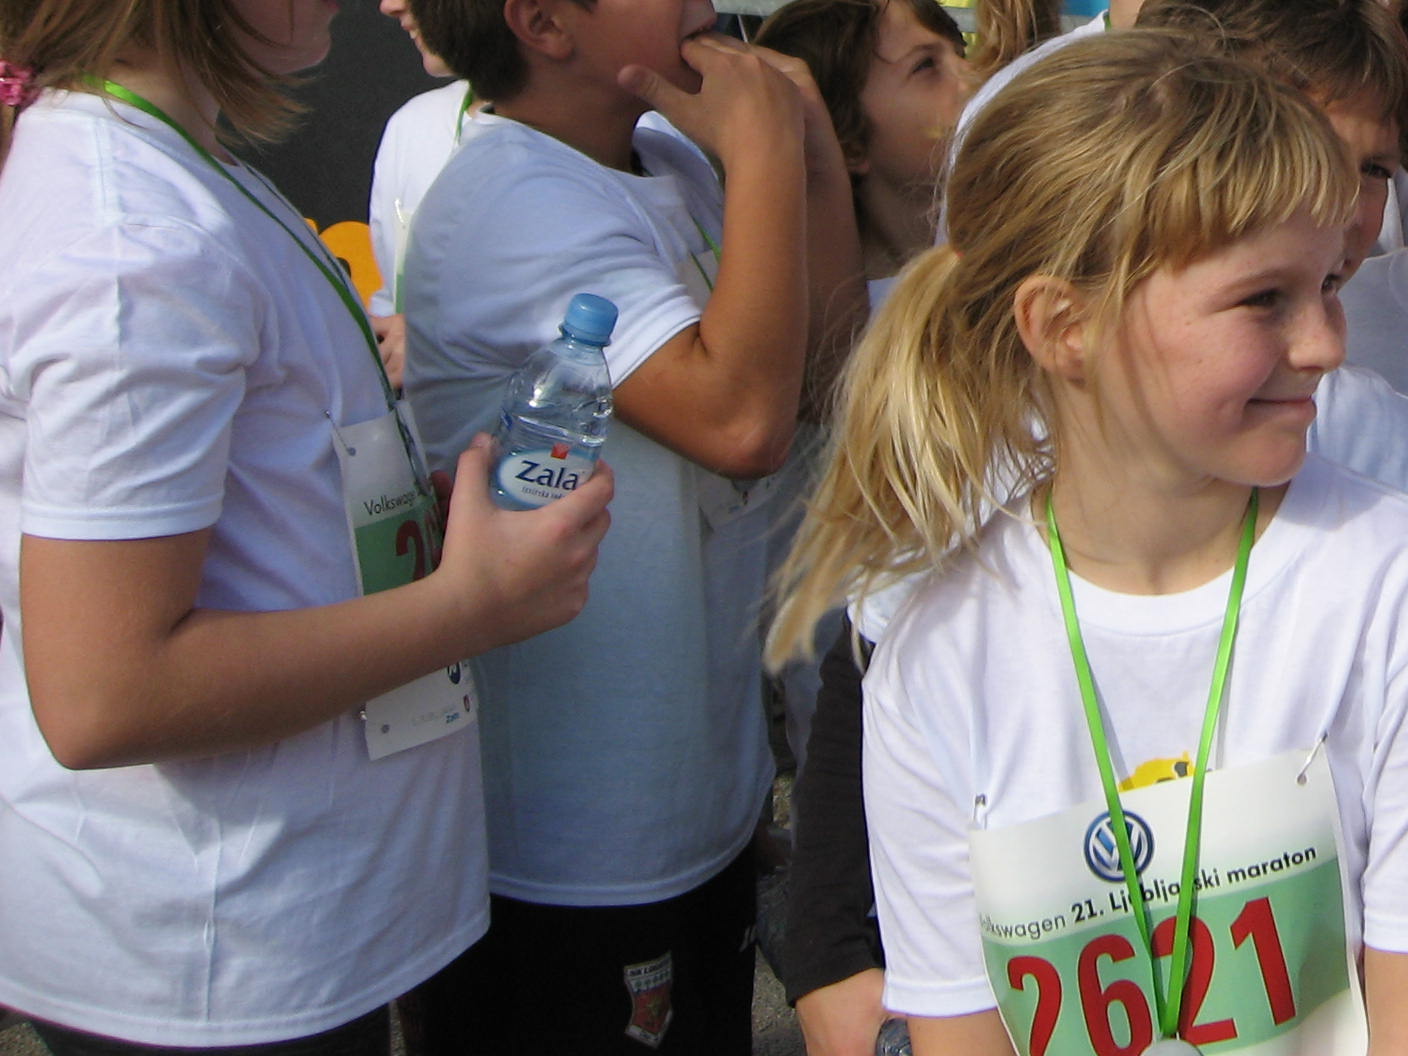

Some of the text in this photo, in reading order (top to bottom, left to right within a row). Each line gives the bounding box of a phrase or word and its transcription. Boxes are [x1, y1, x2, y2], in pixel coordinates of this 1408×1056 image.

[515, 460, 578, 491] Zala
[1071, 899, 1104, 924] 21.
[1109, 868, 1220, 912] Ljbljaski
[1227, 846, 1317, 884] maraton
[1007, 896, 1297, 1056] 2621
